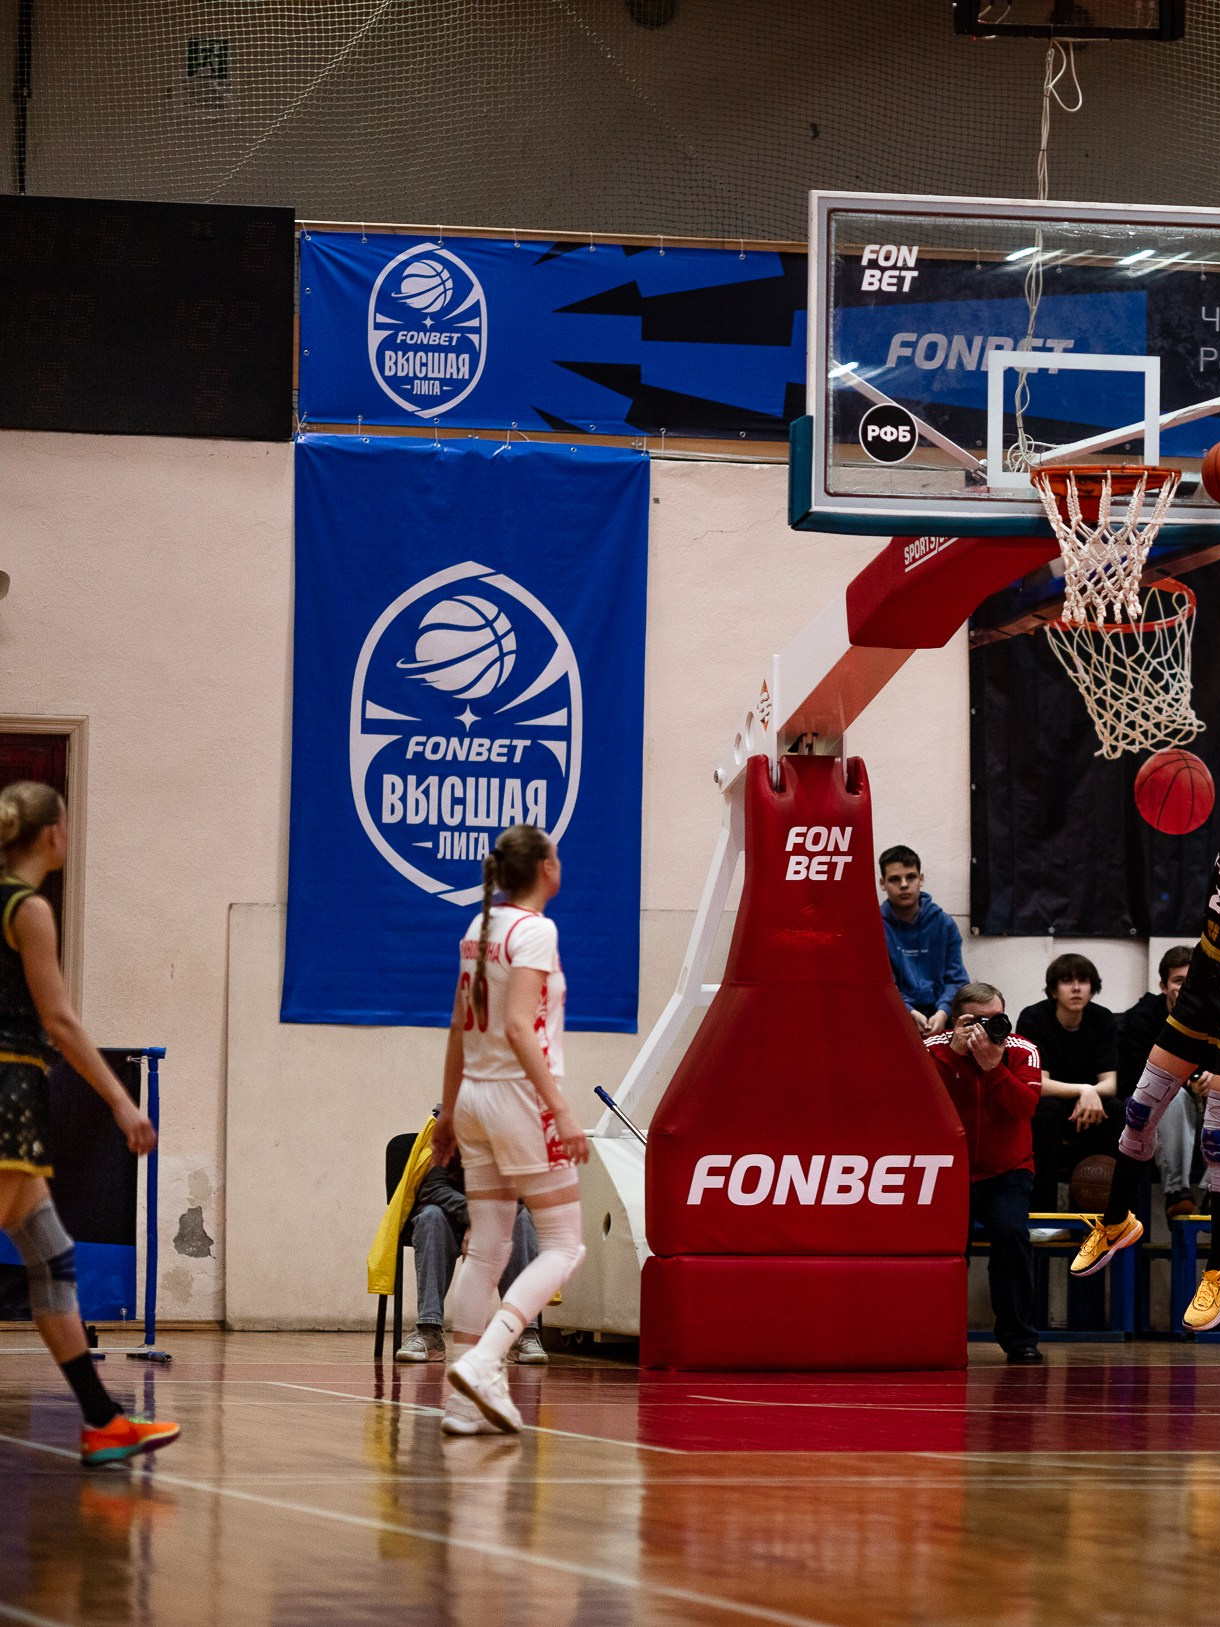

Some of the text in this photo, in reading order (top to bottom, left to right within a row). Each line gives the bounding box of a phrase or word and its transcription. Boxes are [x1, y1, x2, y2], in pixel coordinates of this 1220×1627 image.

[861, 244, 919, 268] FON
[861, 269, 918, 292] BET
[396, 331, 461, 346] FONBET
[384, 350, 470, 379] ВЫСШАЯ
[413, 380, 441, 395] ЛИГА
[866, 425, 911, 443] РФБ
[405, 735, 531, 763] FONBET
[381, 773, 548, 830] ВЫСШАЯ
[437, 831, 490, 861] ЛИГА
[784, 826, 853, 852] FON
[785, 855, 853, 881] BET
[686, 1153, 954, 1206] FONBET
